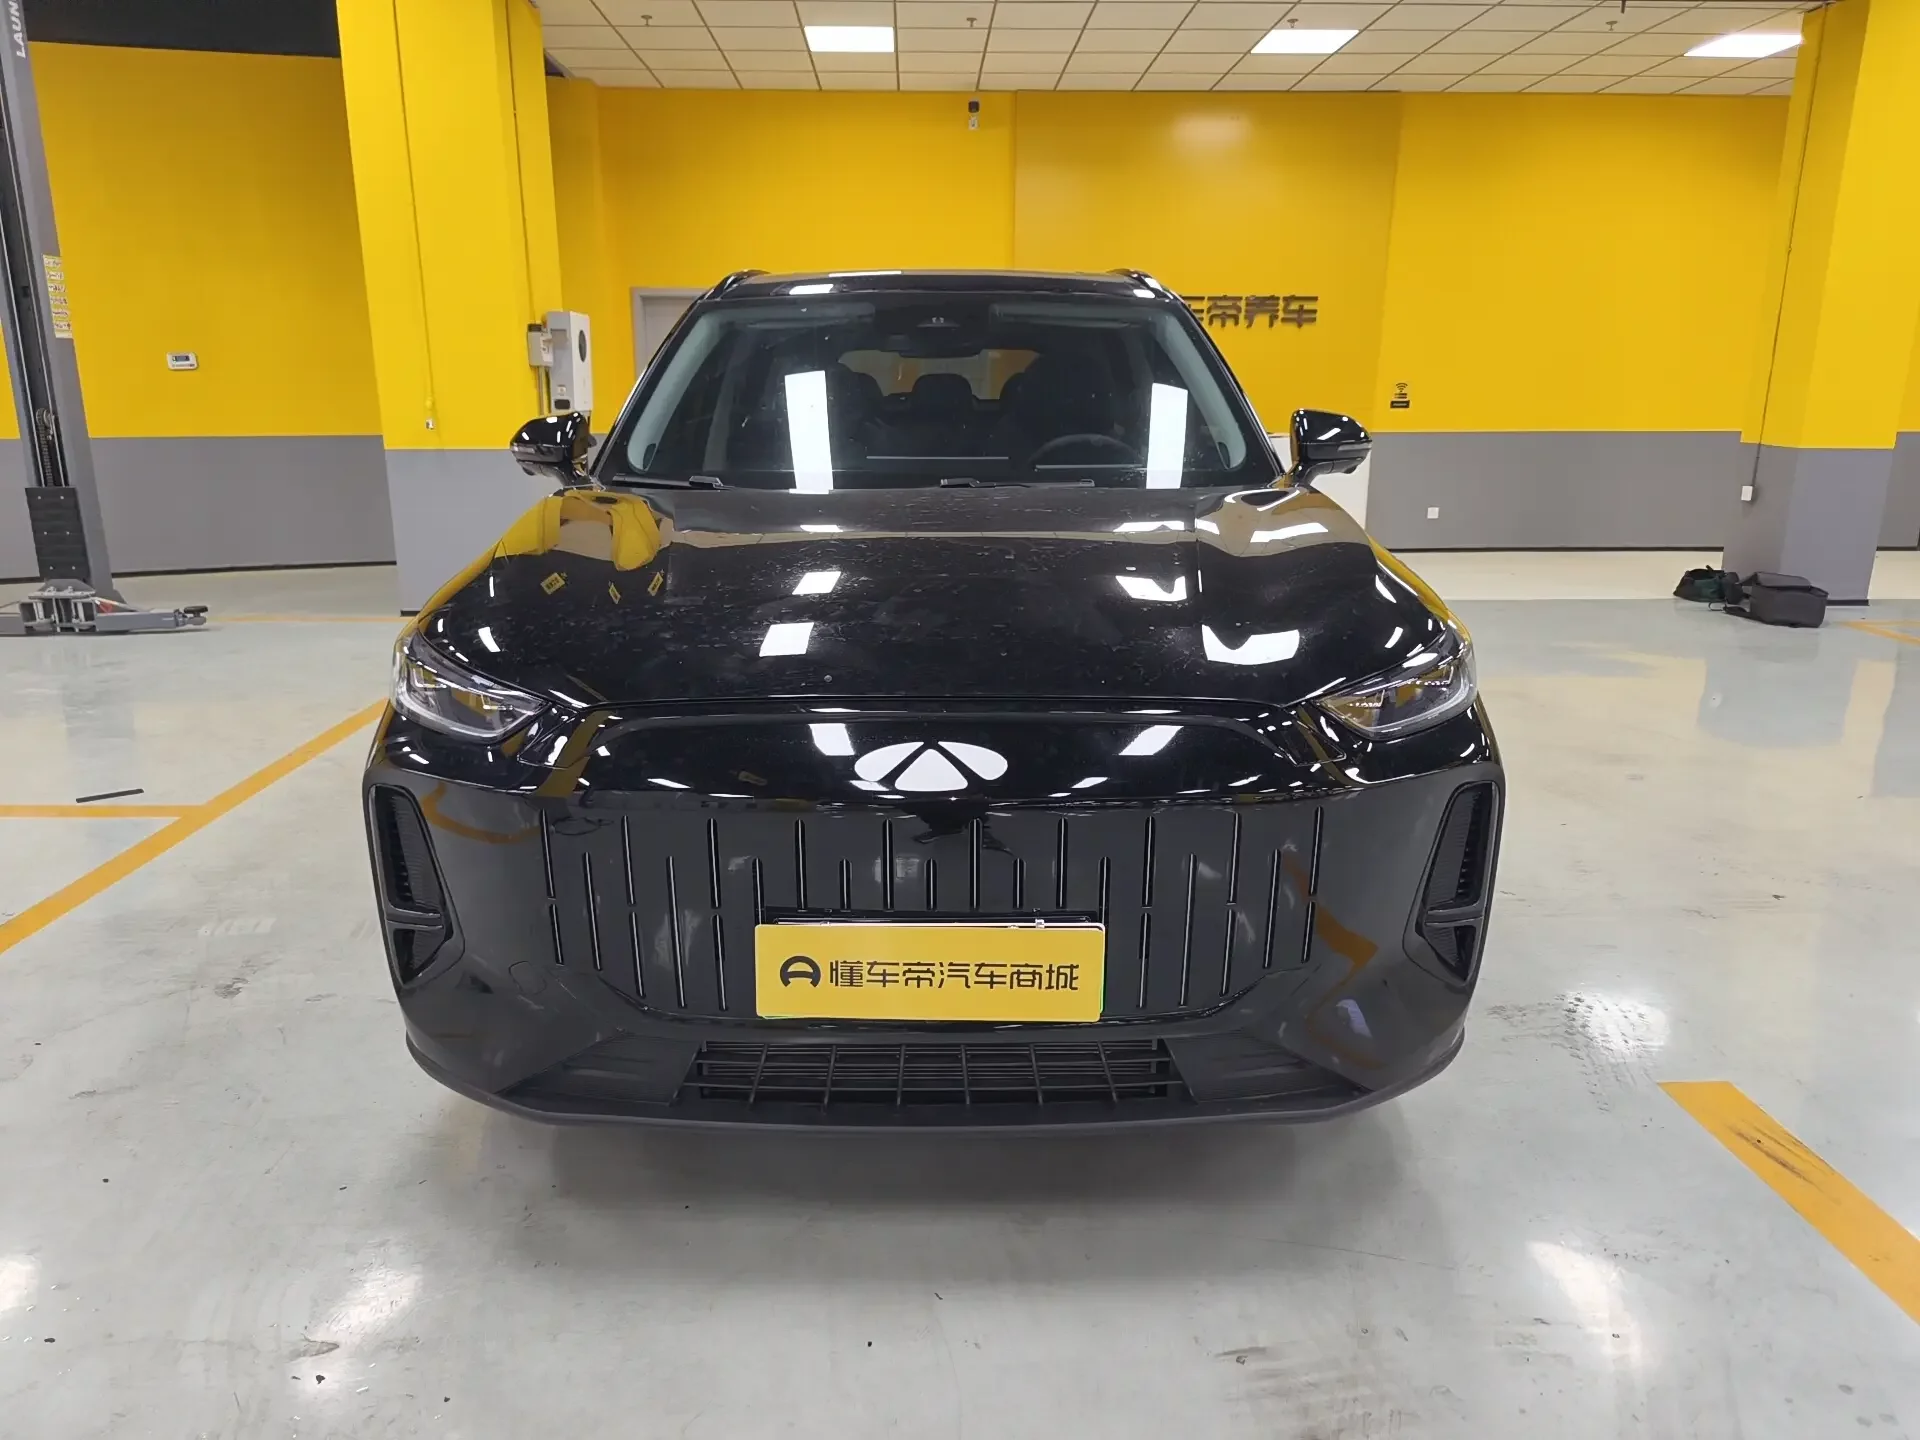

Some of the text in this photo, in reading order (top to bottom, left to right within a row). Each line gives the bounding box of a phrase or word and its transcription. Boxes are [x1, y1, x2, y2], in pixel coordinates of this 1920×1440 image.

[829, 960, 1080, 991] 懂车帝汽车商城
